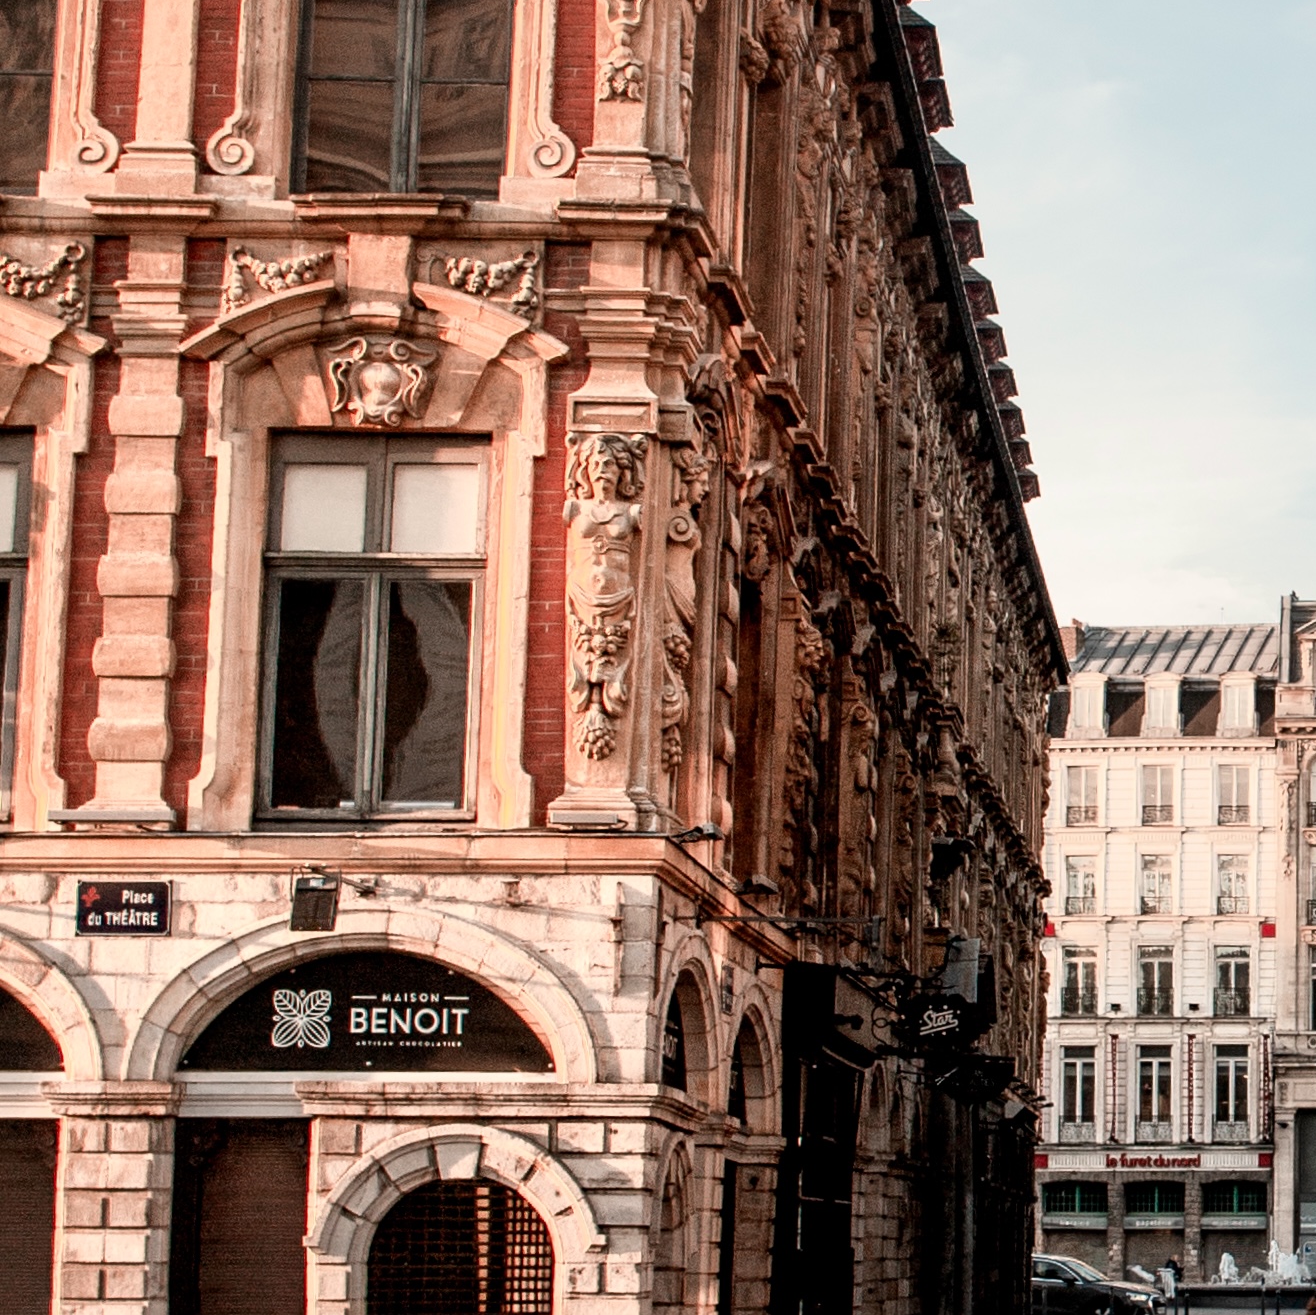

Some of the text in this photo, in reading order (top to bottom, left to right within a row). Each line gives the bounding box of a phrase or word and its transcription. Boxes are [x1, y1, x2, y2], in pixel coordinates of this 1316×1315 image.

[122, 889, 154, 904] Place
[88, 908, 158, 926] du THÉÂTRE
[381, 992, 440, 1003] MAISON
[349, 1006, 470, 1035] BENOIT
[920, 1009, 959, 1033] Star
[1105, 1153, 1201, 1168] le furet du nord
